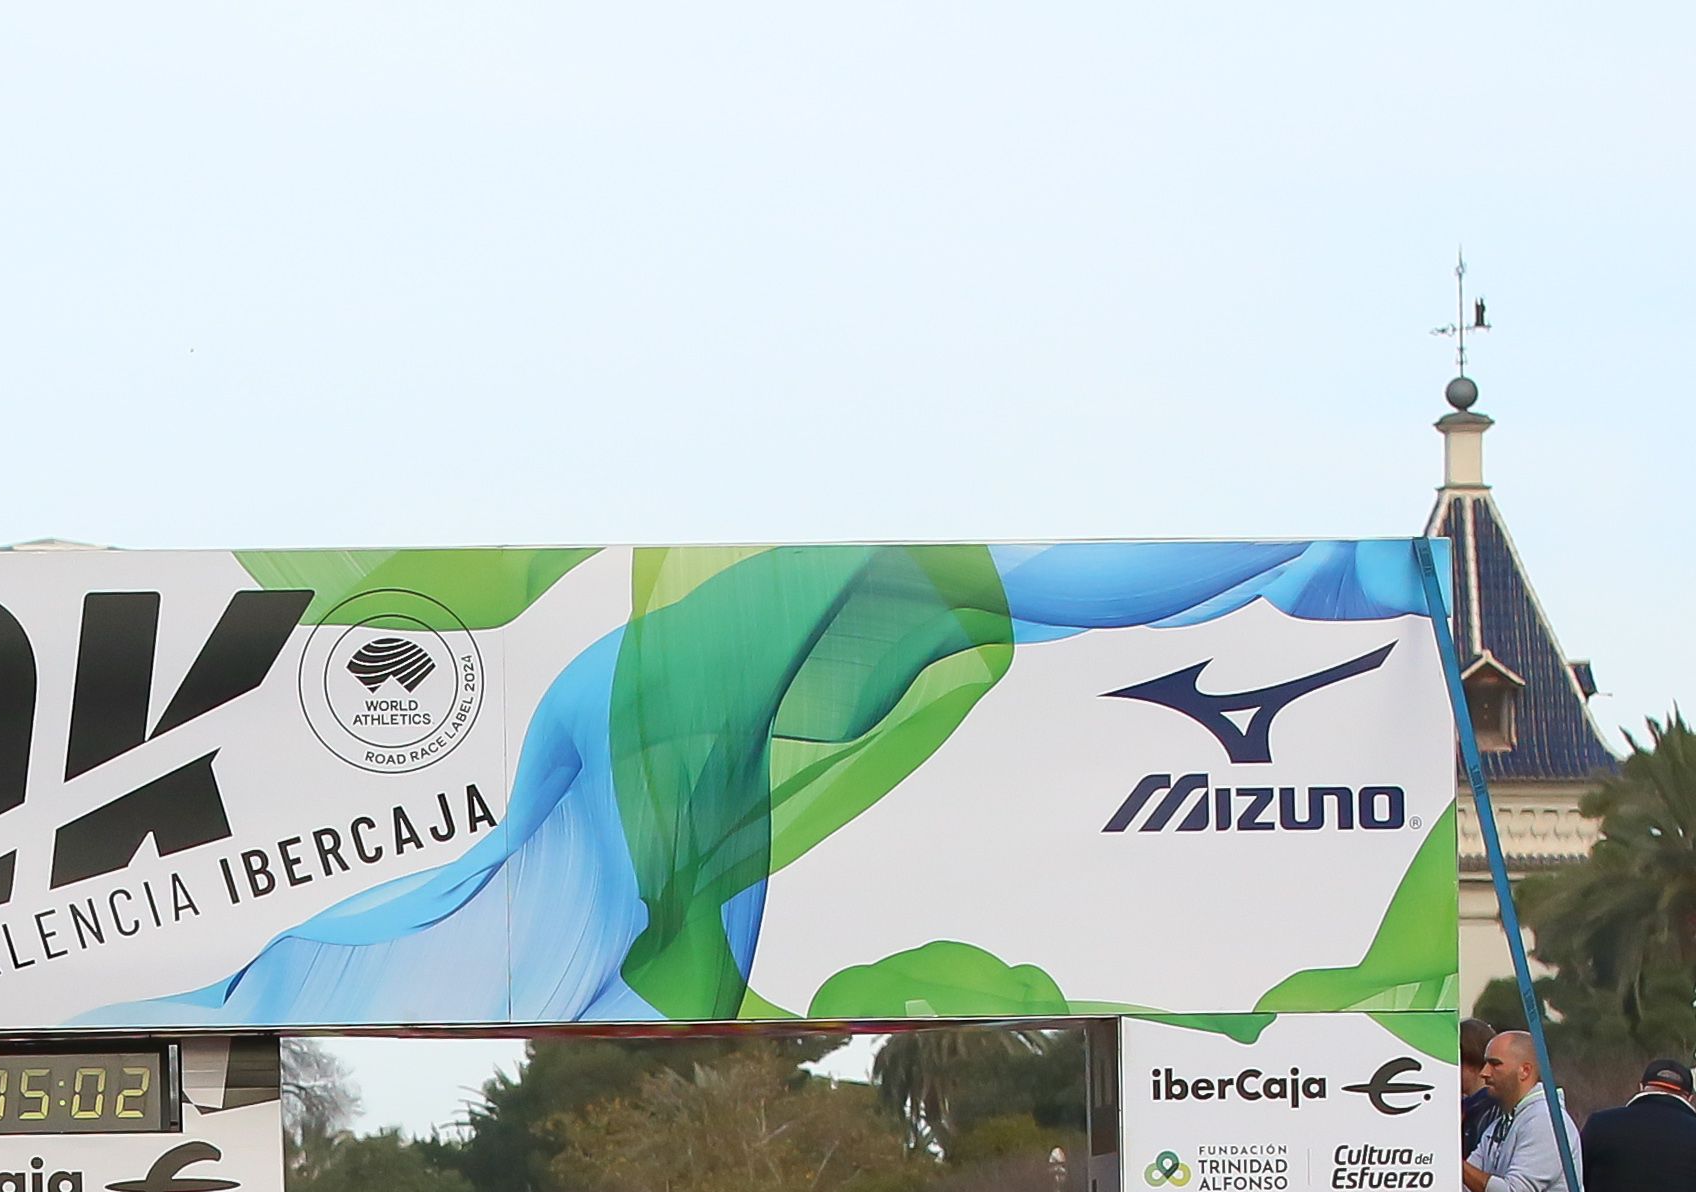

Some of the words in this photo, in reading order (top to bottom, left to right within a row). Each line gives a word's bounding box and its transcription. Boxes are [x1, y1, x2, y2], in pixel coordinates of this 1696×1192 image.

[364, 751, 407, 765] ROAD
[410, 735, 448, 762] RACE
[444, 697, 474, 739] LABEL
[461, 654, 476, 692] 2024
[365, 700, 418, 712] WORLD
[353, 713, 431, 725] ATHLETICS
[1101, 774, 1405, 833] MIZUNO
[219, 783, 497, 905] IBERCAJA
[1152, 1067, 1326, 1108] iberCaja
[1198, 1144, 1288, 1156] FUNDACIÓN
[1333, 1144, 1413, 1166] Cultura
[1415, 1153, 1433, 1165] del
[1198, 1159, 1288, 1174] TRINIDAD
[1198, 1176, 1288, 1191] ALFONSO
[1331, 1167, 1435, 1190] Esfuerzo
